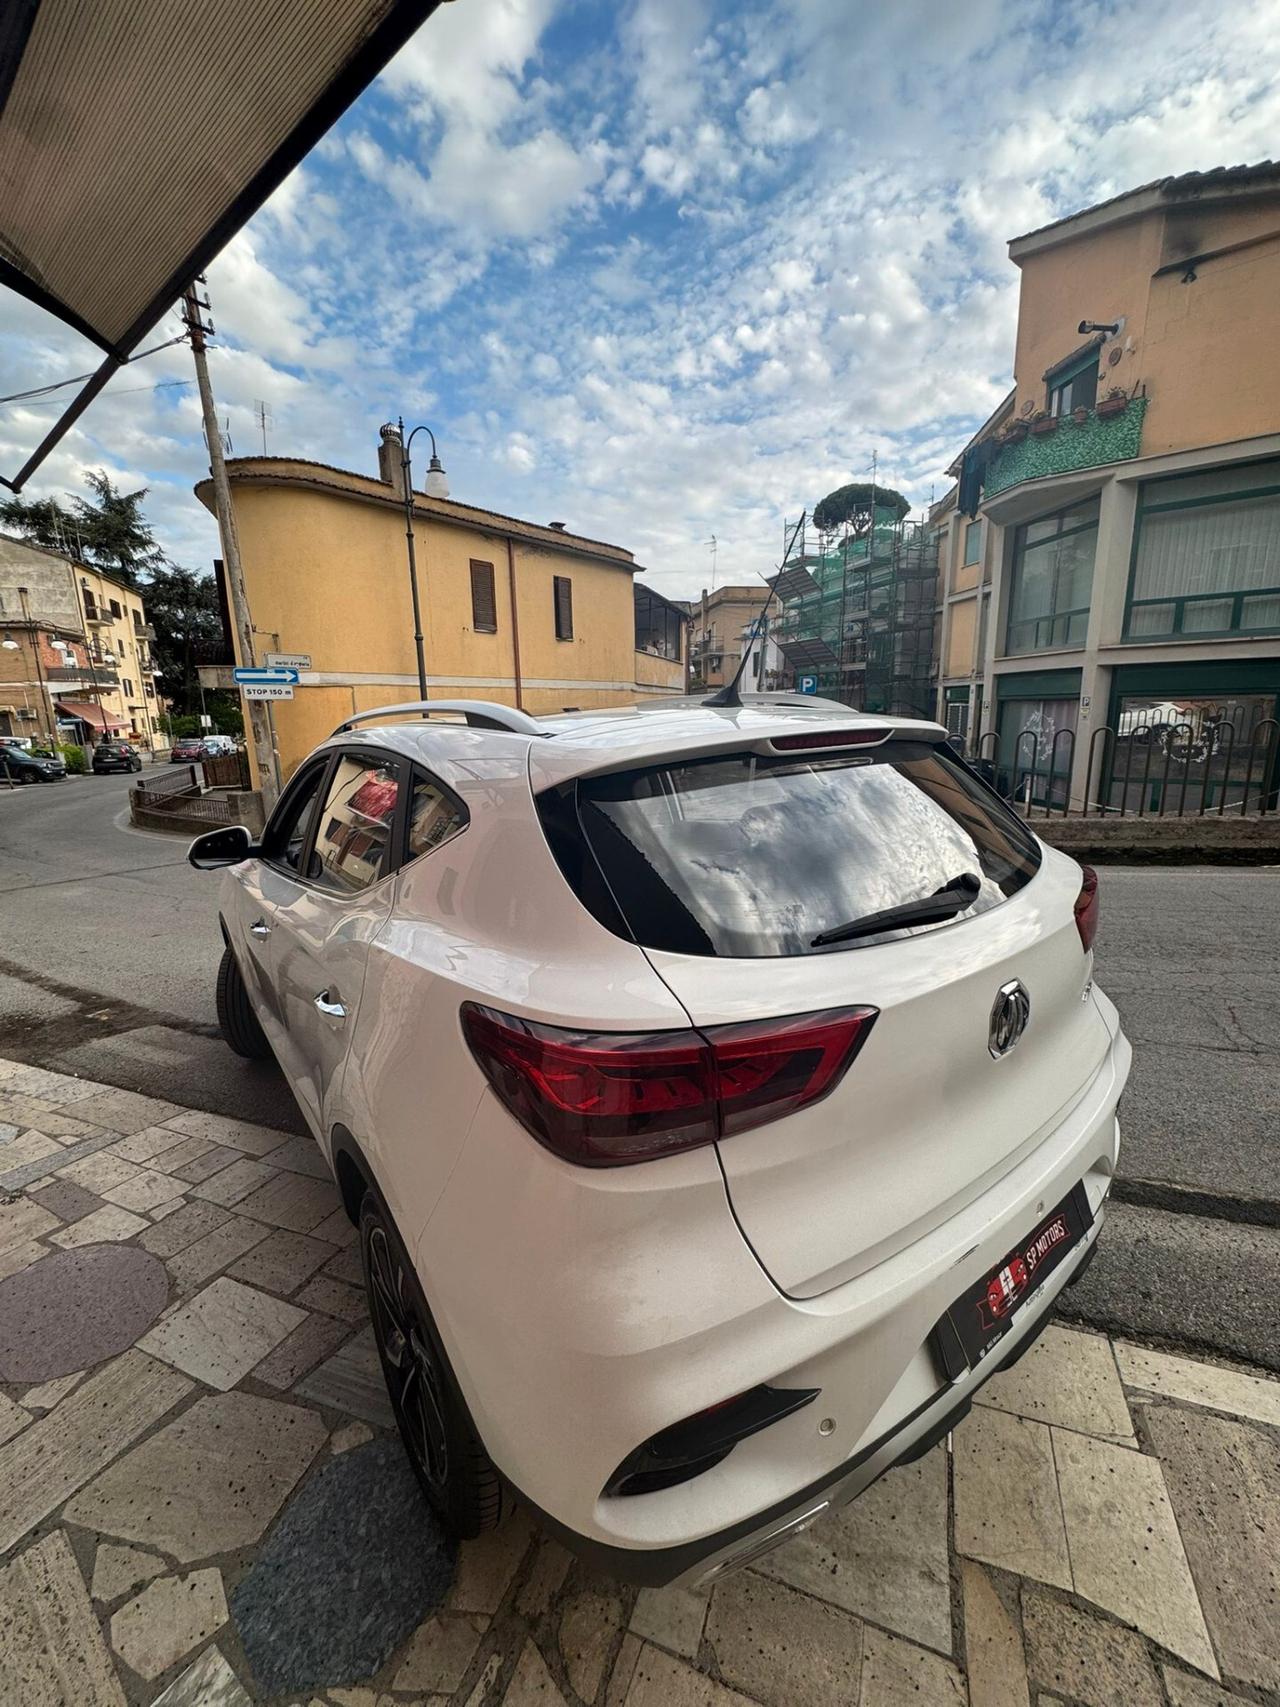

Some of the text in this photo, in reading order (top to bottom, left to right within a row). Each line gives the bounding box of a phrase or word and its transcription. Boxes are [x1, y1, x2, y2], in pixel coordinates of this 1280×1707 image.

[802, 678, 813, 692] P
[1026, 1246, 1037, 1270] SP
[1035, 1219, 1066, 1257] MOTORS
